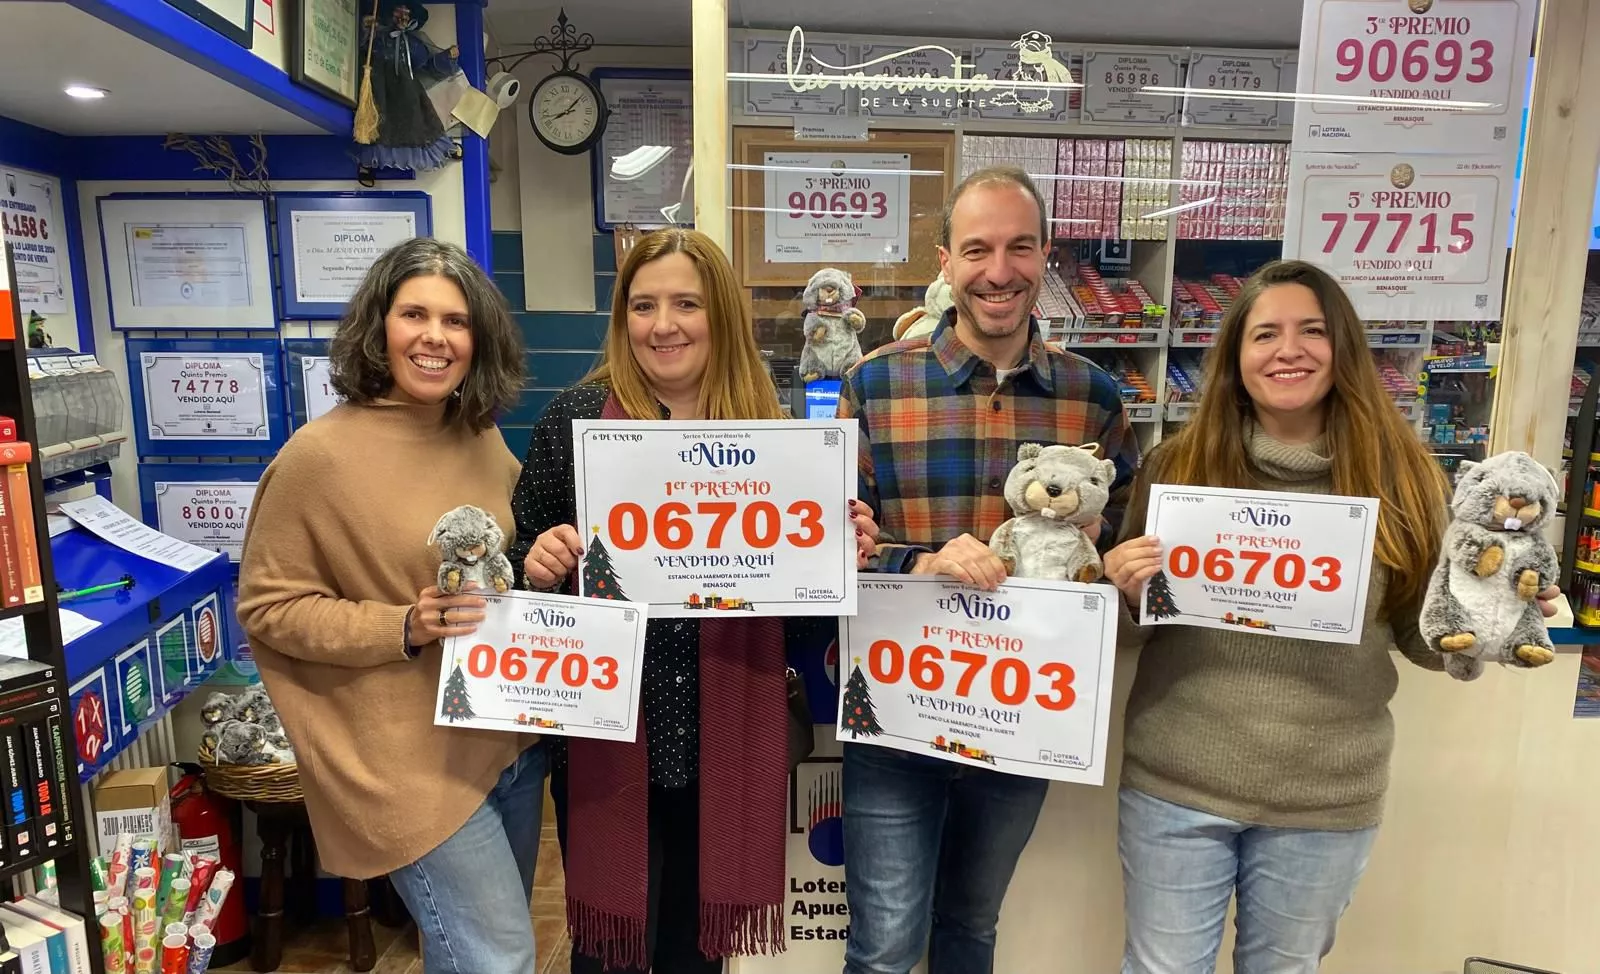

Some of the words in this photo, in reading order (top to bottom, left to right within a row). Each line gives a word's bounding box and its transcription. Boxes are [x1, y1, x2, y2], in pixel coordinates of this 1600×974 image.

[1389, 16, 1471, 35] PREMIO
[1335, 38, 1495, 83] 90693
[1105, 72, 1159, 85] 86986
[1208, 75, 1261, 88] 91179
[1369, 89, 1420, 99] VENDIDO
[861, 97, 880, 107] DE
[892, 98, 911, 107] LA
[921, 98, 986, 108] SUERTE
[819, 178, 871, 189] PREMIO
[788, 191, 888, 219] 90693
[1371, 191, 1451, 208] PREMIO
[811, 222, 843, 231] VENDIDO
[1321, 213, 1475, 254] 77715
[333, 234, 376, 242] DIPLOMA
[1353, 259, 1401, 270] VENDIDO
[185, 362, 222, 370] DIPLOMA
[180, 371, 204, 379] Quinto
[171, 380, 239, 394] 74778
[177, 396, 214, 404] VENDIDO
[215, 395, 236, 404] AQUÍ
[592, 433, 598, 441] 6
[600, 433, 612, 441] DE
[612, 433, 643, 442] ENERO
[678, 450, 692, 463] El
[692, 441, 756, 467] Niño
[195, 489, 232, 497] DIPLOMA
[665, 481, 687, 496] 1er
[690, 478, 770, 498] PREMIO
[191, 498, 214, 506] Quinto
[182, 506, 248, 520] 86007
[1228, 511, 1240, 521] El
[1239, 506, 1291, 527] Niño
[188, 522, 224, 530] VENDIDO
[225, 520, 245, 530] AQUÍ
[607, 499, 826, 551] 06703
[1216, 533, 1234, 544] 1er
[1235, 534, 1301, 549] PREMIO
[654, 555, 730, 568] VENDIDO
[733, 552, 775, 569] AQUÍ
[1168, 545, 1342, 592] 06703
[1201, 584, 1261, 598] VENDIDO
[1263, 590, 1298, 603] AQUÍ
[936, 598, 950, 610] El
[949, 592, 1011, 621] Niño
[522, 611, 533, 622] El
[532, 607, 576, 628] Niño
[511, 632, 527, 643] 1er
[528, 634, 584, 650] PREMIO
[922, 625, 943, 639] 1er
[945, 629, 1024, 653] PREMIO
[467, 643, 619, 691] 06703
[867, 638, 1077, 712] 06703
[497, 684, 551, 697] VENDIDO
[551, 688, 582, 701] AQUÍ
[907, 693, 976, 716] VENDIDO
[979, 706, 1022, 725] AQUÍ
[918, 712, 942, 722] ESTANCO
[52, 724, 61, 750] KARIN
[948, 727, 981, 738] BENASQUE
[1052, 758, 1086, 767] NACIONAL
[1053, 753, 1080, 761] LOTERÍA
[54, 750, 65, 782] FOSSUM
[37, 780, 50, 802] TODO
[791, 925, 850, 940] Estad
